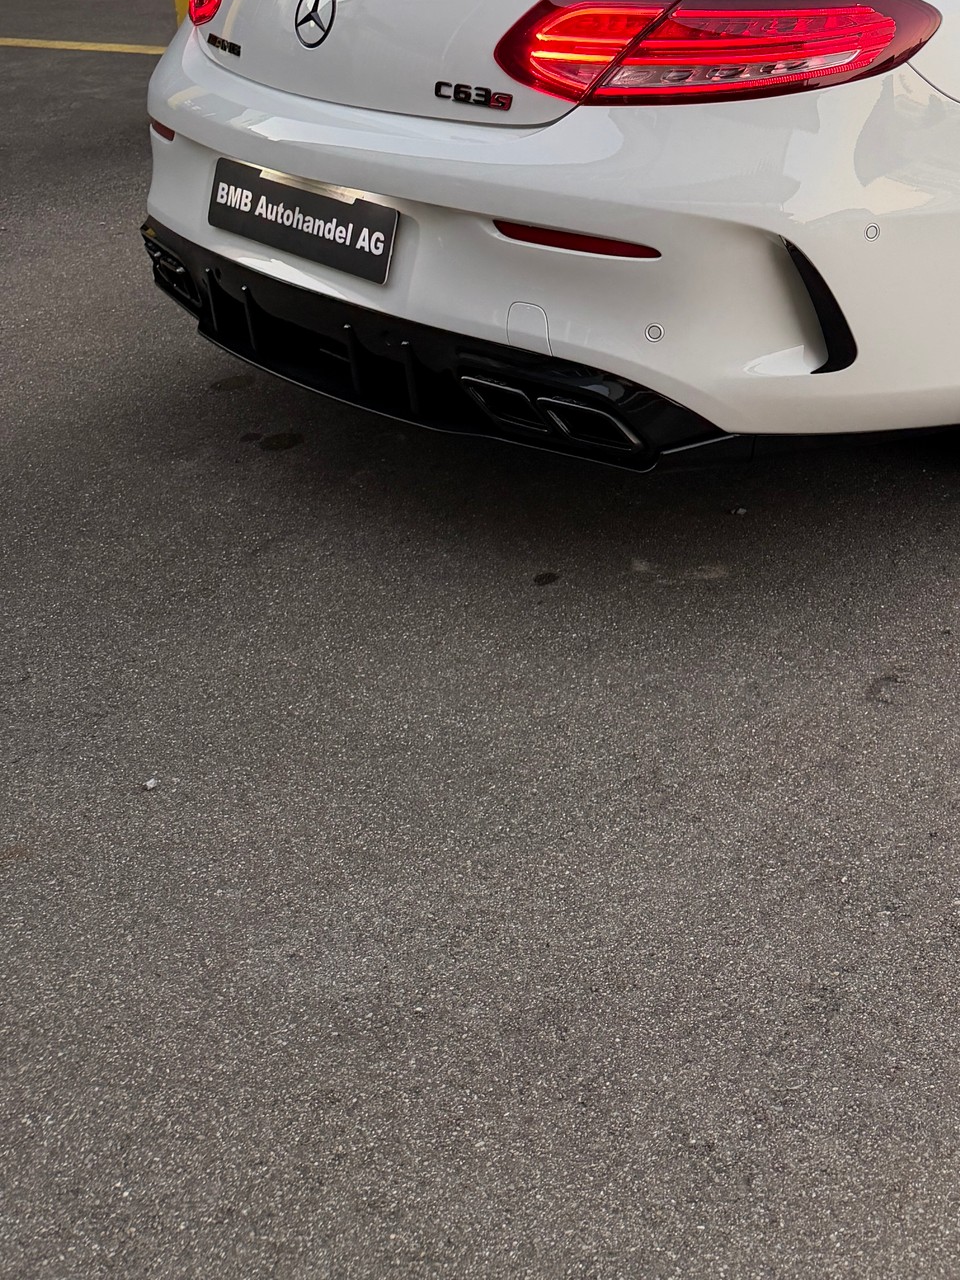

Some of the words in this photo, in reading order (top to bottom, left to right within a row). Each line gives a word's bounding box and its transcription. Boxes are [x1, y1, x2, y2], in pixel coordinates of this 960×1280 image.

[216, 181, 253, 212] BMB
[255, 195, 354, 246] Autohandel
[355, 227, 386, 256] AG
